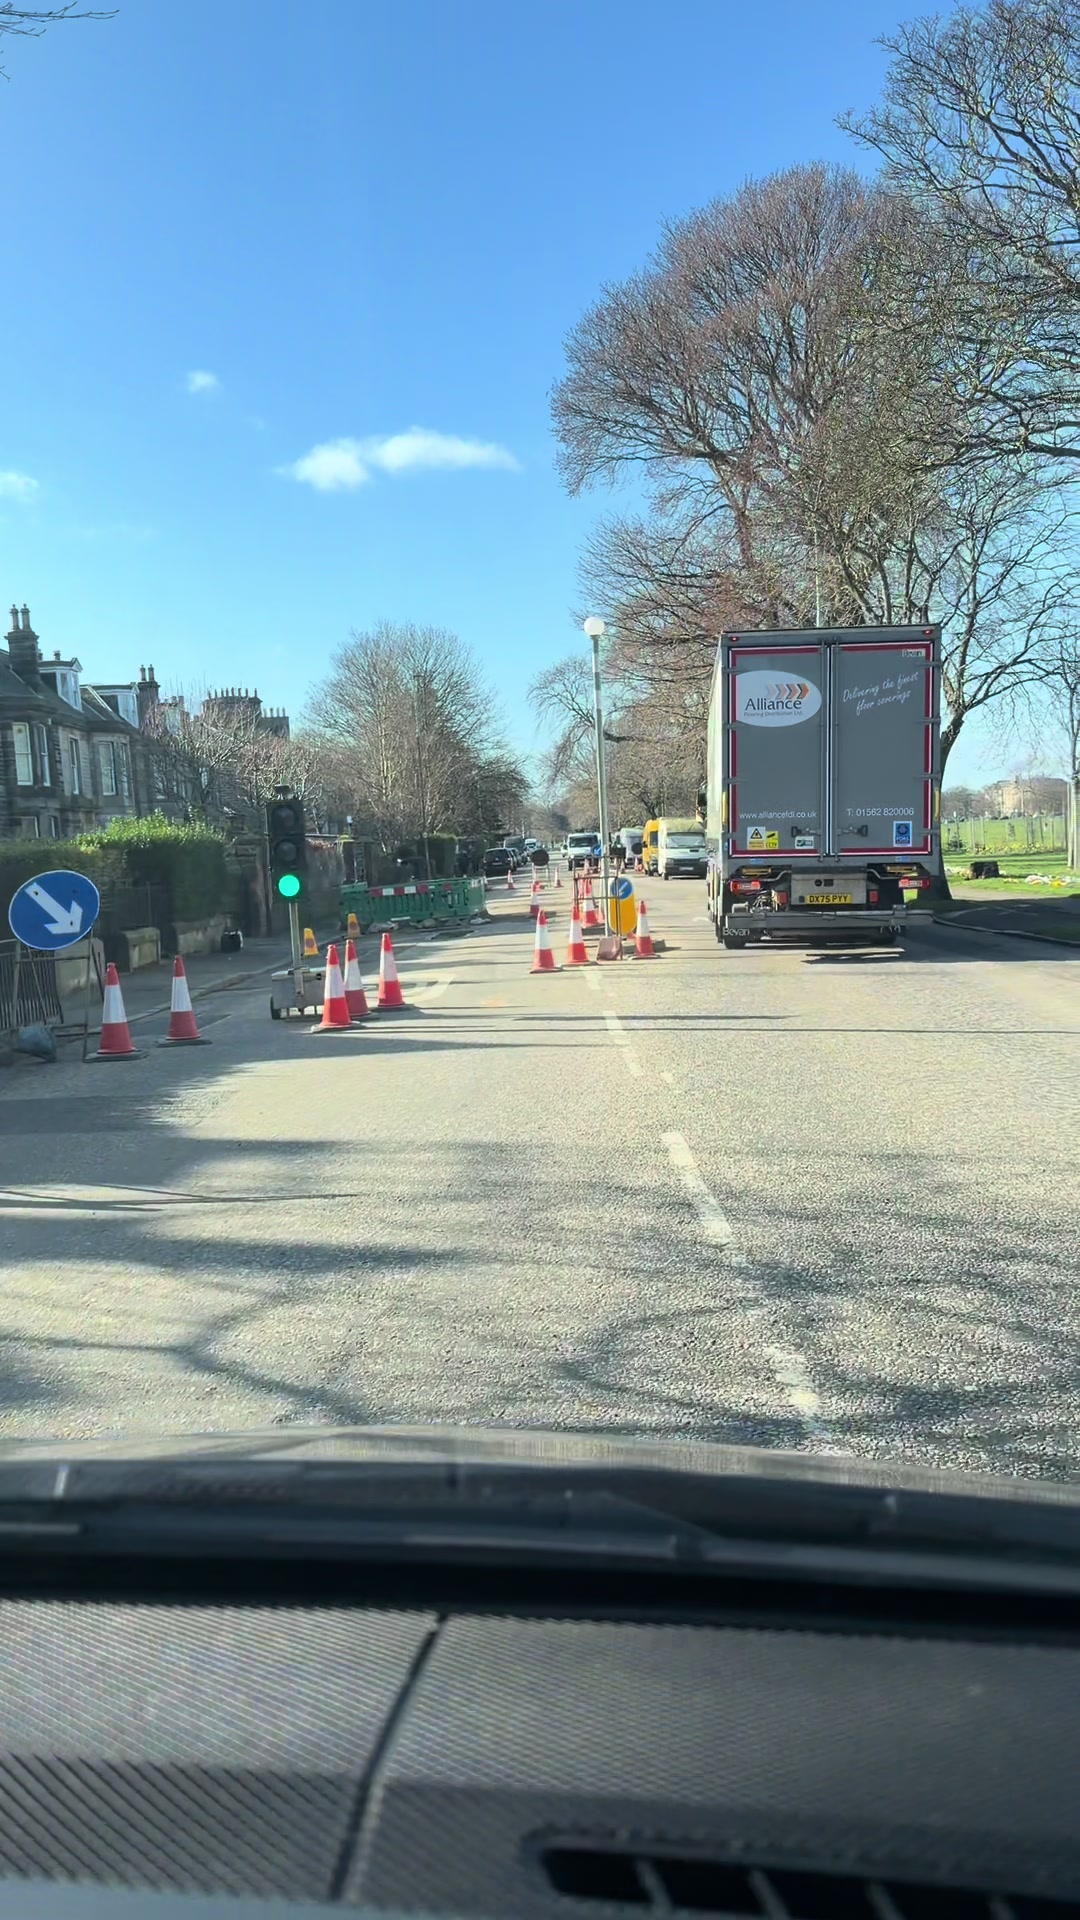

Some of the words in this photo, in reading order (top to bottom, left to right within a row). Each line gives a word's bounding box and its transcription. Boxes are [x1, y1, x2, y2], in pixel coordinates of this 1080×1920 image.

[843, 684, 880, 702] Delivering
[882, 678, 895, 688] the
[897, 671, 919, 690] finest
[744, 697, 802, 711] Alliance
[856, 698, 875, 716] floor
[877, 689, 911, 704] coverings
[739, 810, 817, 819] www.alliancefdl.co.uk
[847, 808, 854, 817] T:
[856, 808, 881, 817] 01562
[883, 807, 914, 817] 820006
[809, 895, 831, 903] DX75
[832, 894, 848, 902] PYY
[722, 927, 750, 936] Bevan
